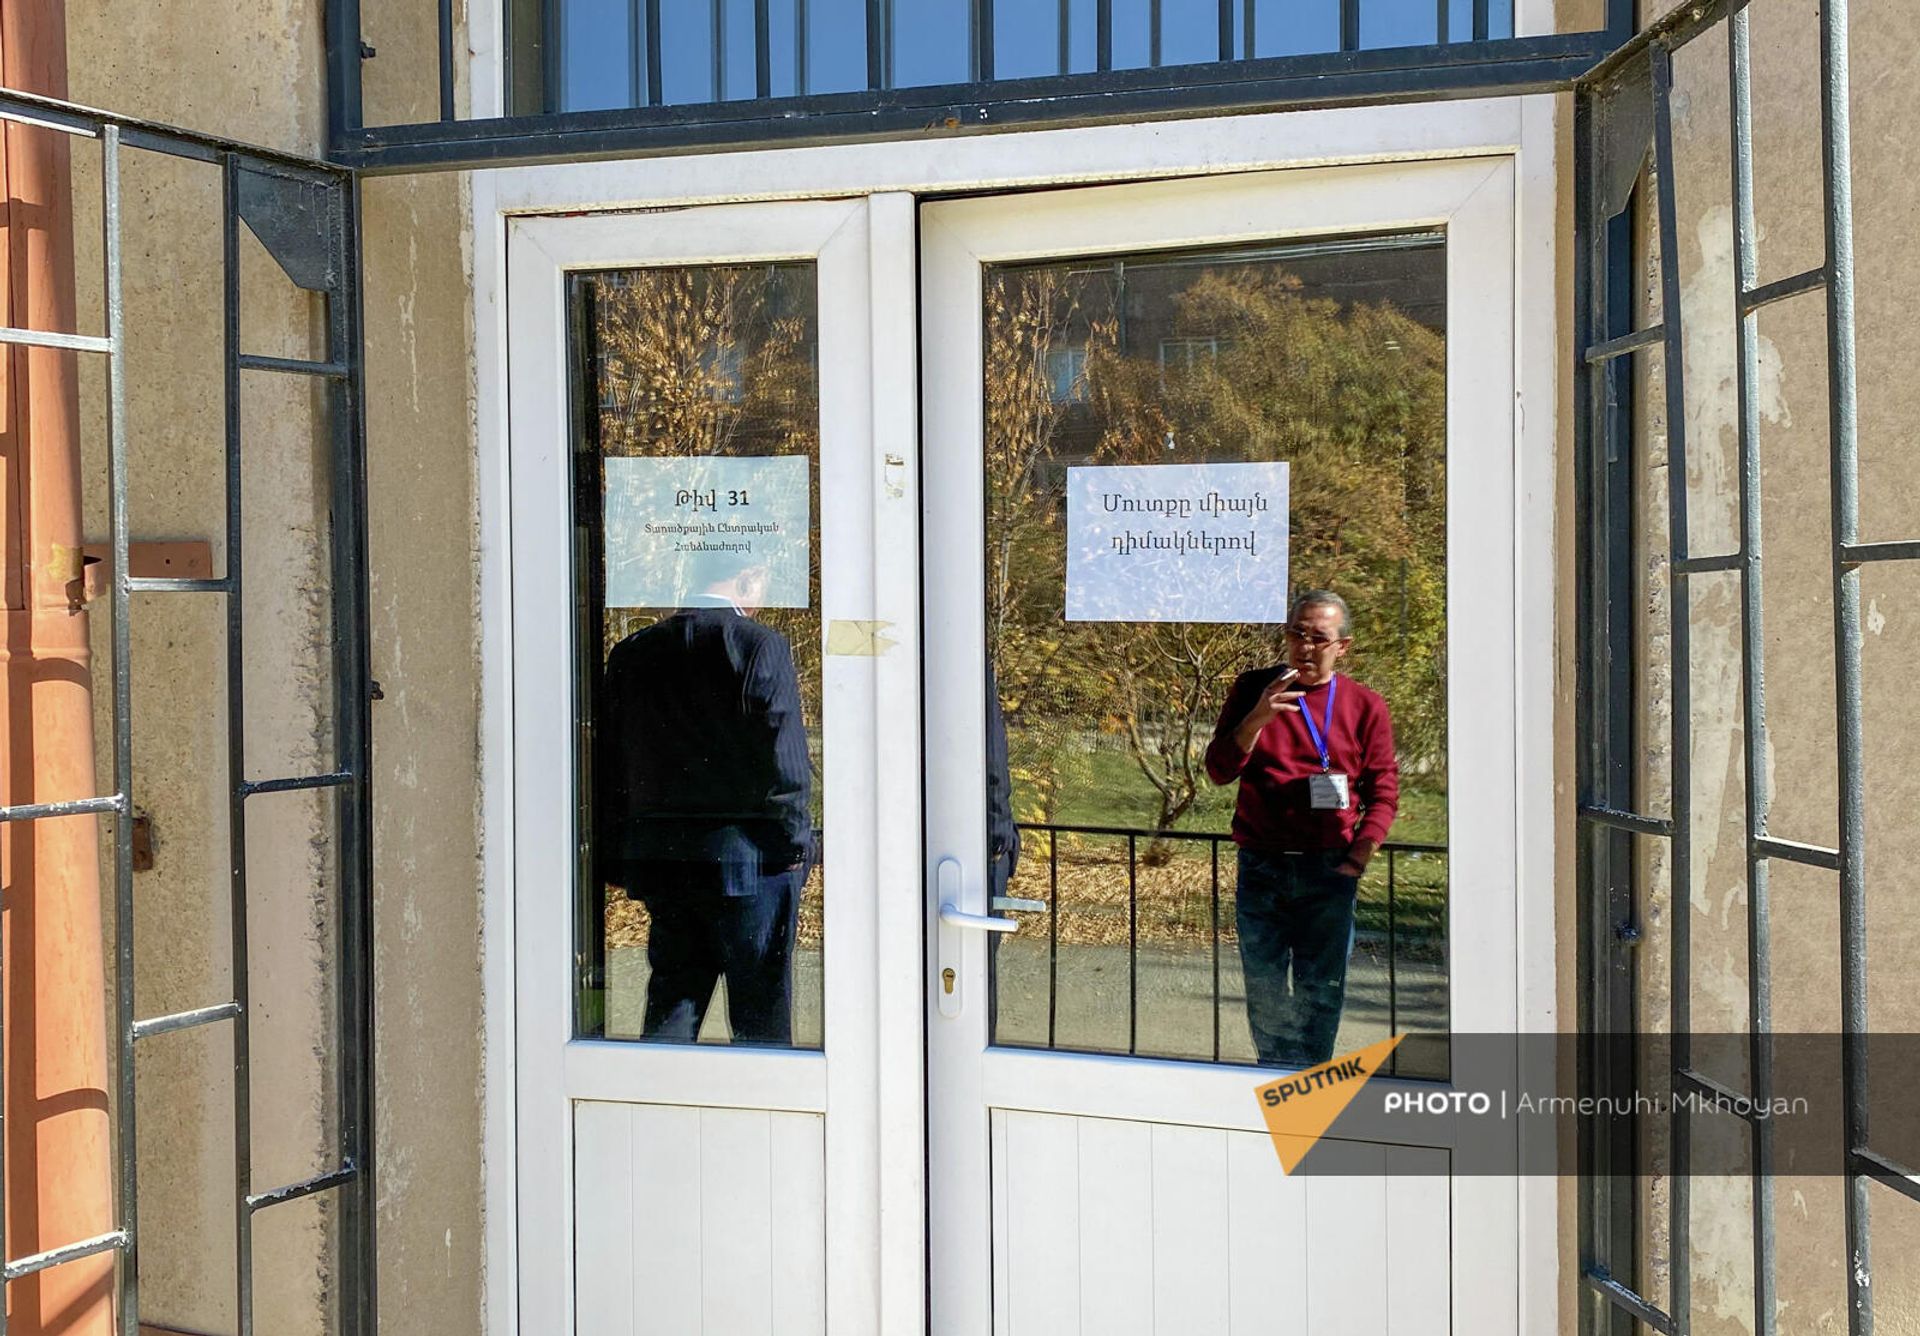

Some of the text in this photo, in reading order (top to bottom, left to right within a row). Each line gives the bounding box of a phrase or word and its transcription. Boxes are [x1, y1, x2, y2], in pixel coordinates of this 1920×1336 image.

[674, 489, 750, 512] Թիվ 31
[1103, 492, 1269, 518] Մուտքը միայն
[644, 522, 779, 536] Տարածքային Ընտրական
[674, 540, 752, 554] Հանձնաժողով
[1112, 530, 1257, 556] դիմակներով
